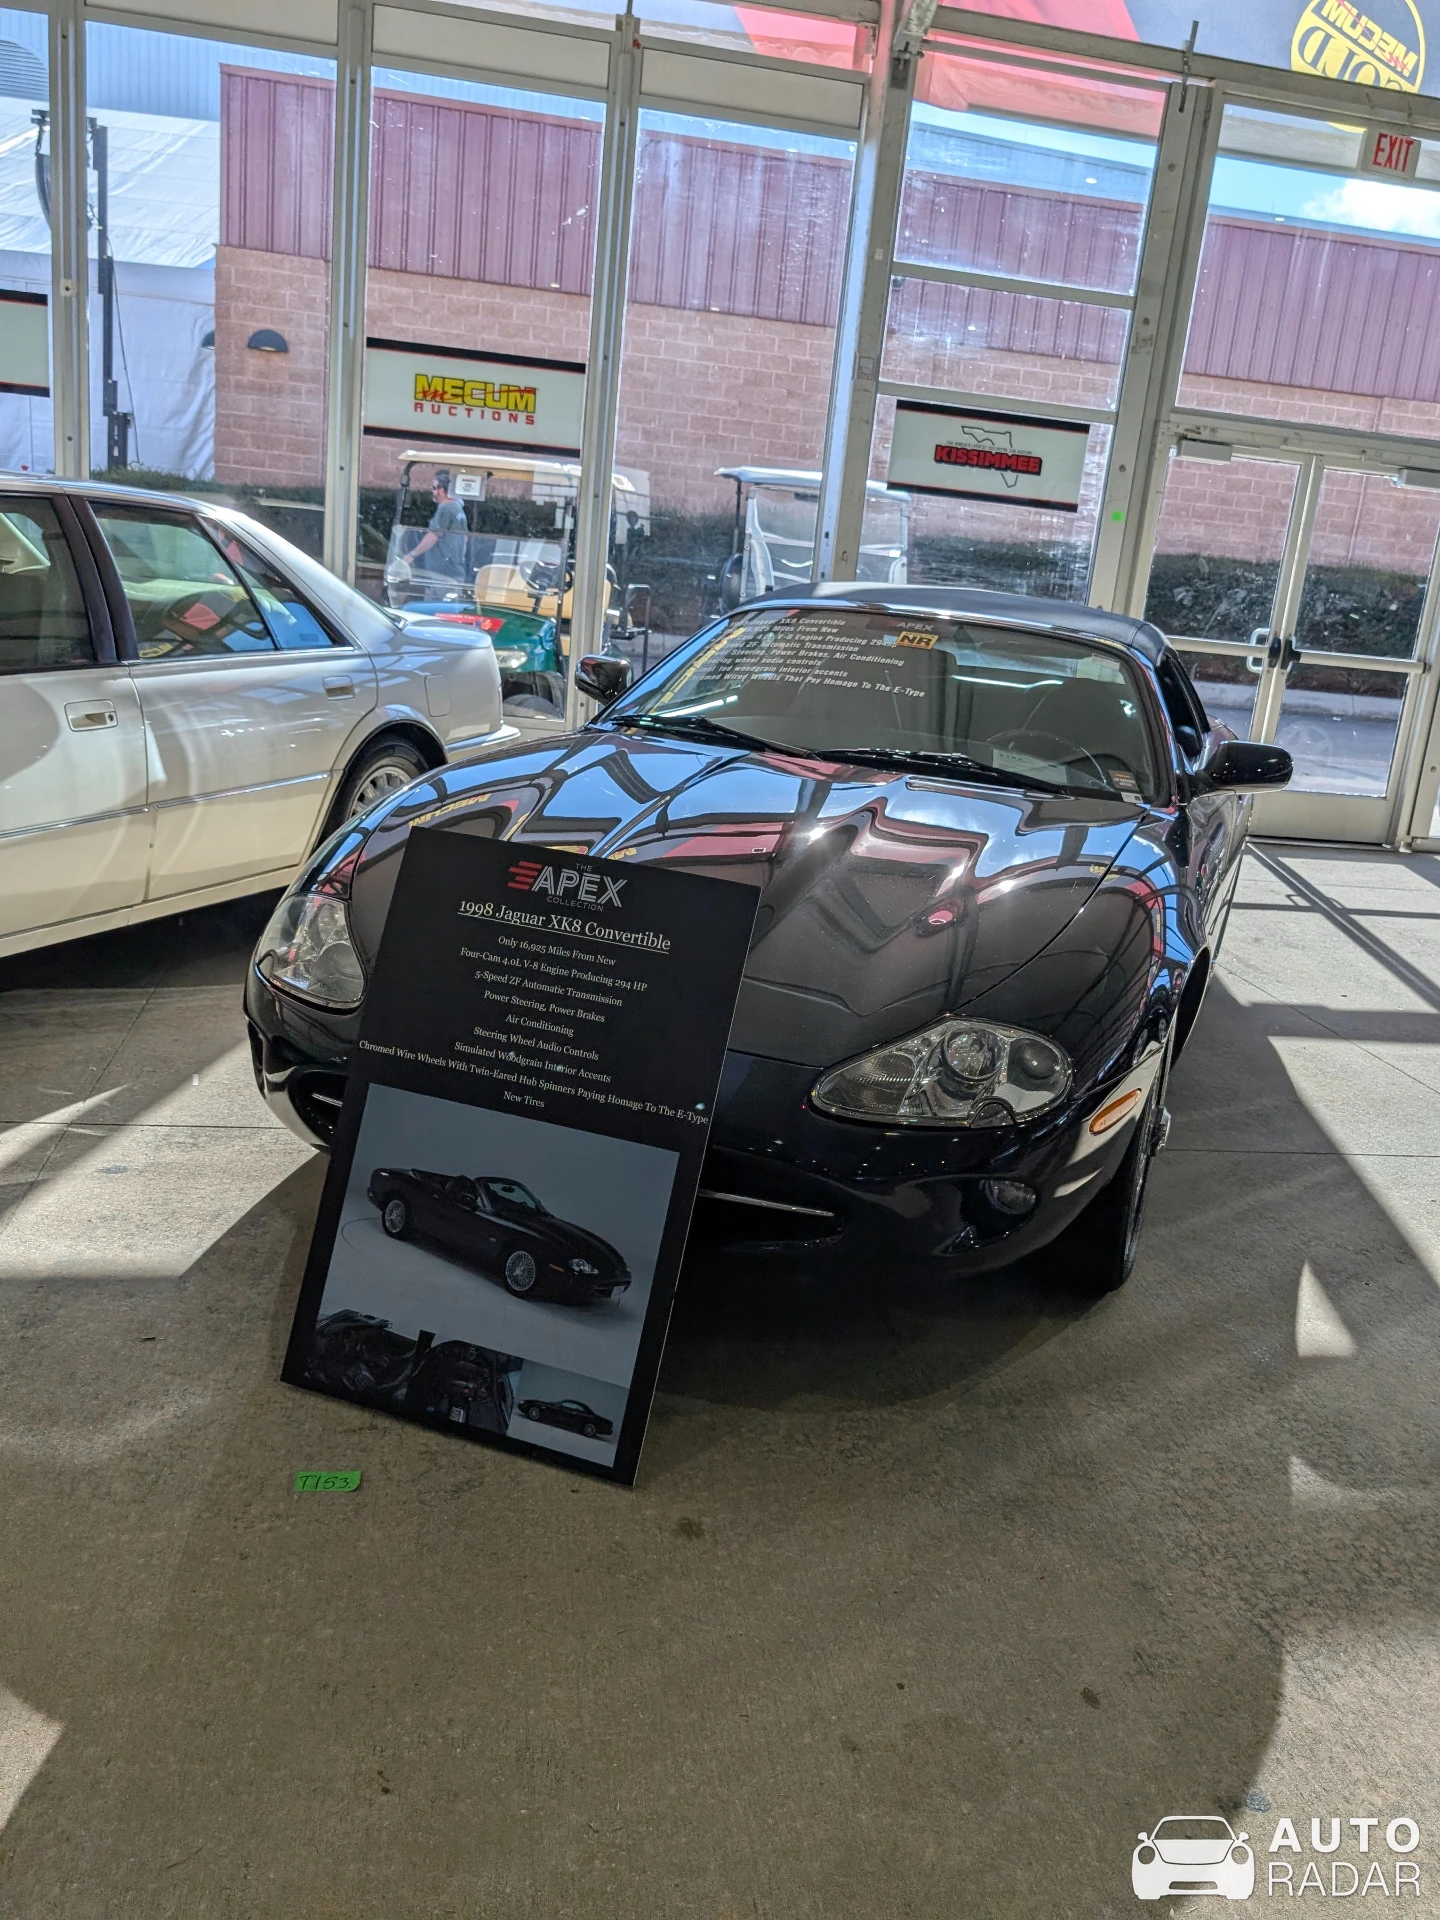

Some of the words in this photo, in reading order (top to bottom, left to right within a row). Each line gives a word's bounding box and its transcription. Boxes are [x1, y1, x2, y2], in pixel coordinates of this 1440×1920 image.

[1372, 132, 1414, 173] EXIT
[414, 374, 537, 413] MECUM
[413, 402, 535, 425] AUCTIONS
[934, 444, 1042, 476] KISSIMMEE
[799, 618, 846, 626] Convertible
[795, 634, 823, 642] Engine
[825, 635, 867, 645] Producing
[804, 642, 859, 652] Transmission
[899, 635, 932, 646] NR
[779, 666, 812, 674] interior
[814, 669, 848, 678] accents
[786, 658, 822, 666] controls
[849, 654, 905, 667] Conditioning
[804, 677, 821, 686] Pay
[823, 678, 859, 688] Homage
[862, 681, 872, 690] To
[875, 683, 891, 692] The
[893, 686, 926, 698] E-Type
[575, 862, 594, 873] THE
[530, 865, 628, 908] APEX
[546, 895, 604, 912] COLLECTION
[458, 900, 494, 917] 1998
[495, 904, 547, 927] Jaguar
[547, 914, 582, 933] XK8
[584, 921, 671, 951] Convertible
[498, 935, 519, 949] Only
[519, 940, 547, 954] 16,925
[547, 945, 571, 958] Miles
[572, 949, 595, 962] From
[595, 954, 616, 966] New
[460, 946, 501, 963] Four-Cam
[501, 957, 522, 967] 4.0L
[523, 959, 539, 970] V-8
[540, 962, 570, 977] Engine
[570, 968, 614, 987] Producing
[614, 979, 631, 991] 294
[632, 981, 648, 992] HP
[474, 970, 509, 984] 5-Speed
[508, 975, 522, 986] ZF
[521, 978, 566, 995] Automatic
[566, 987, 623, 1007] Transmission
[483, 989, 510, 1003] Power
[510, 995, 547, 1012] Steering,
[548, 1003, 576, 1017] Power
[576, 1008, 606, 1023] Brakes
[504, 1014, 520, 1024] Air
[520, 1016, 575, 1038] Conditioning
[473, 1026, 508, 1043] Steering
[509, 1033, 536, 1047] Wheel
[535, 1039, 562, 1053] Audio
[563, 1045, 600, 1061] Controls
[454, 1041, 497, 1058] Simulated
[497, 1050, 543, 1069] Woodgrain
[544, 1060, 578, 1076] Interior
[577, 1068, 612, 1083] Accents
[358, 1039, 396, 1056] Chromed
[396, 1047, 416, 1060] Wire
[417, 1052, 447, 1067] Wheels
[448, 1059, 468, 1072] With
[469, 1063, 518, 1083] Twin-Eared
[518, 1074, 538, 1087] Hub
[538, 1079, 576, 1095] Spinners
[576, 1087, 607, 1104] Paying
[606, 1093, 644, 1111] Homage
[645, 1101, 657, 1113] To
[658, 1104, 676, 1117] The
[676, 1109, 709, 1125] E-Type
[503, 1090, 523, 1103] New
[523, 1095, 545, 1108] Tires
